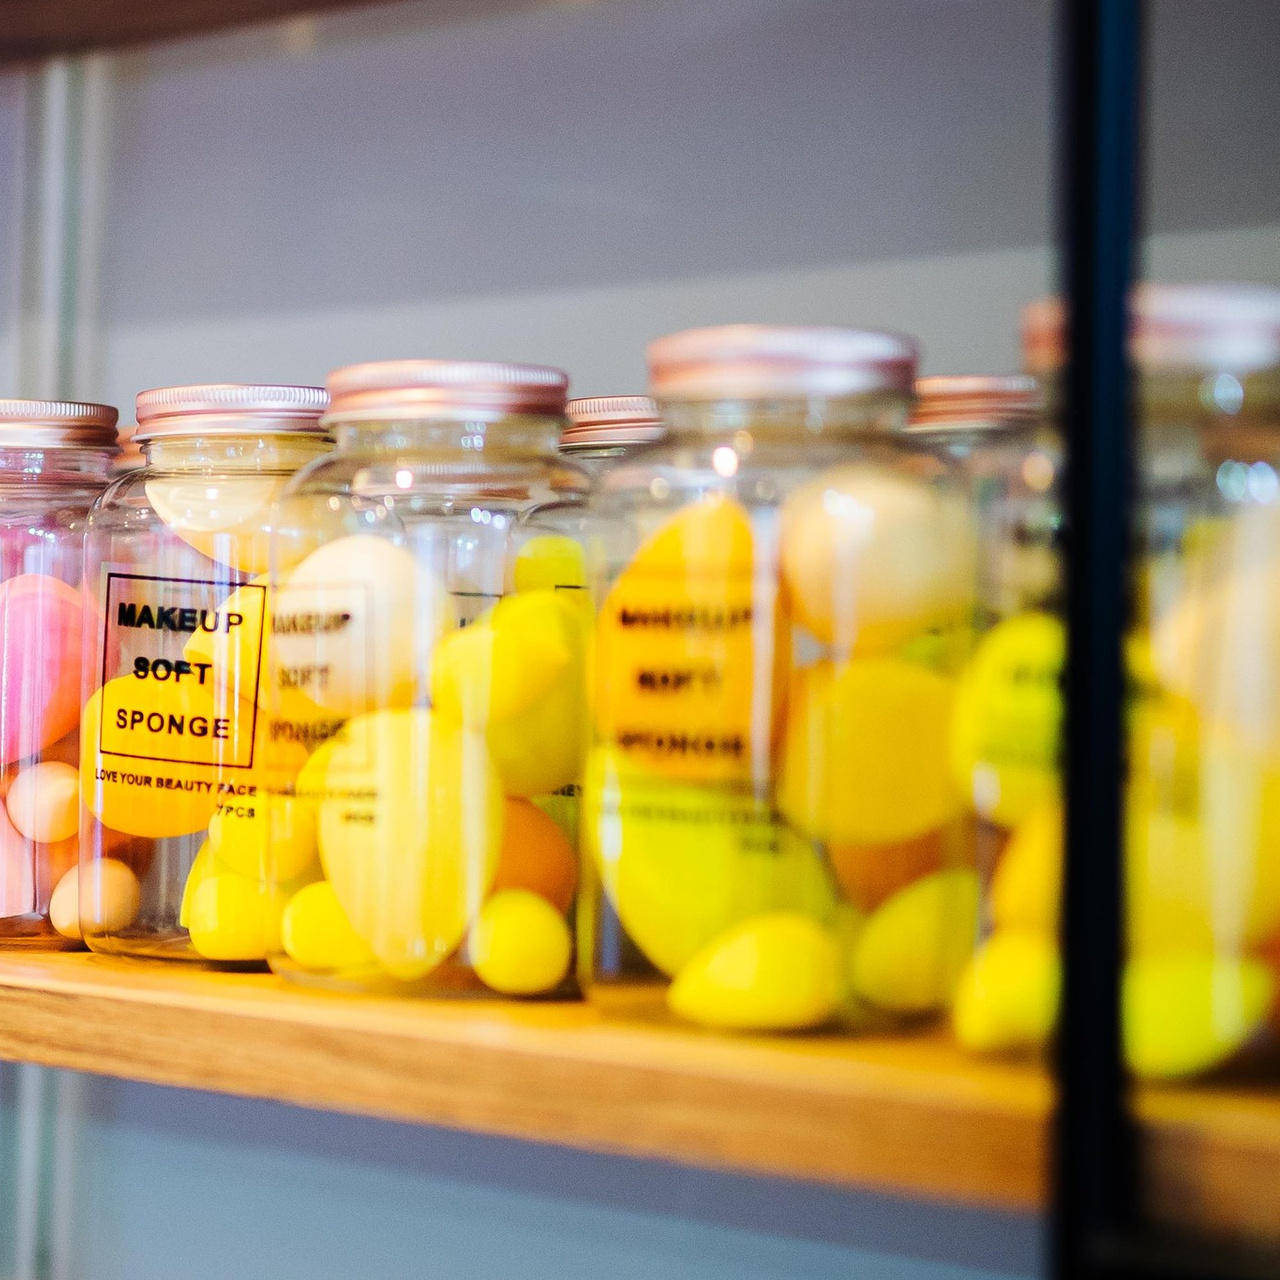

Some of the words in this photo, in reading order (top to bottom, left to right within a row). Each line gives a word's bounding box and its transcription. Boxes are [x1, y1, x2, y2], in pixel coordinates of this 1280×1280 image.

[117, 601, 244, 634] MAKEUP
[132, 656, 212, 685] SOFT
[116, 708, 230, 740] SPONGE
[95, 767, 118, 783] LOVE
[120, 771, 152, 788] YOUR
[155, 777, 213, 795] BEAUTY
[217, 782, 258, 798] FACE
